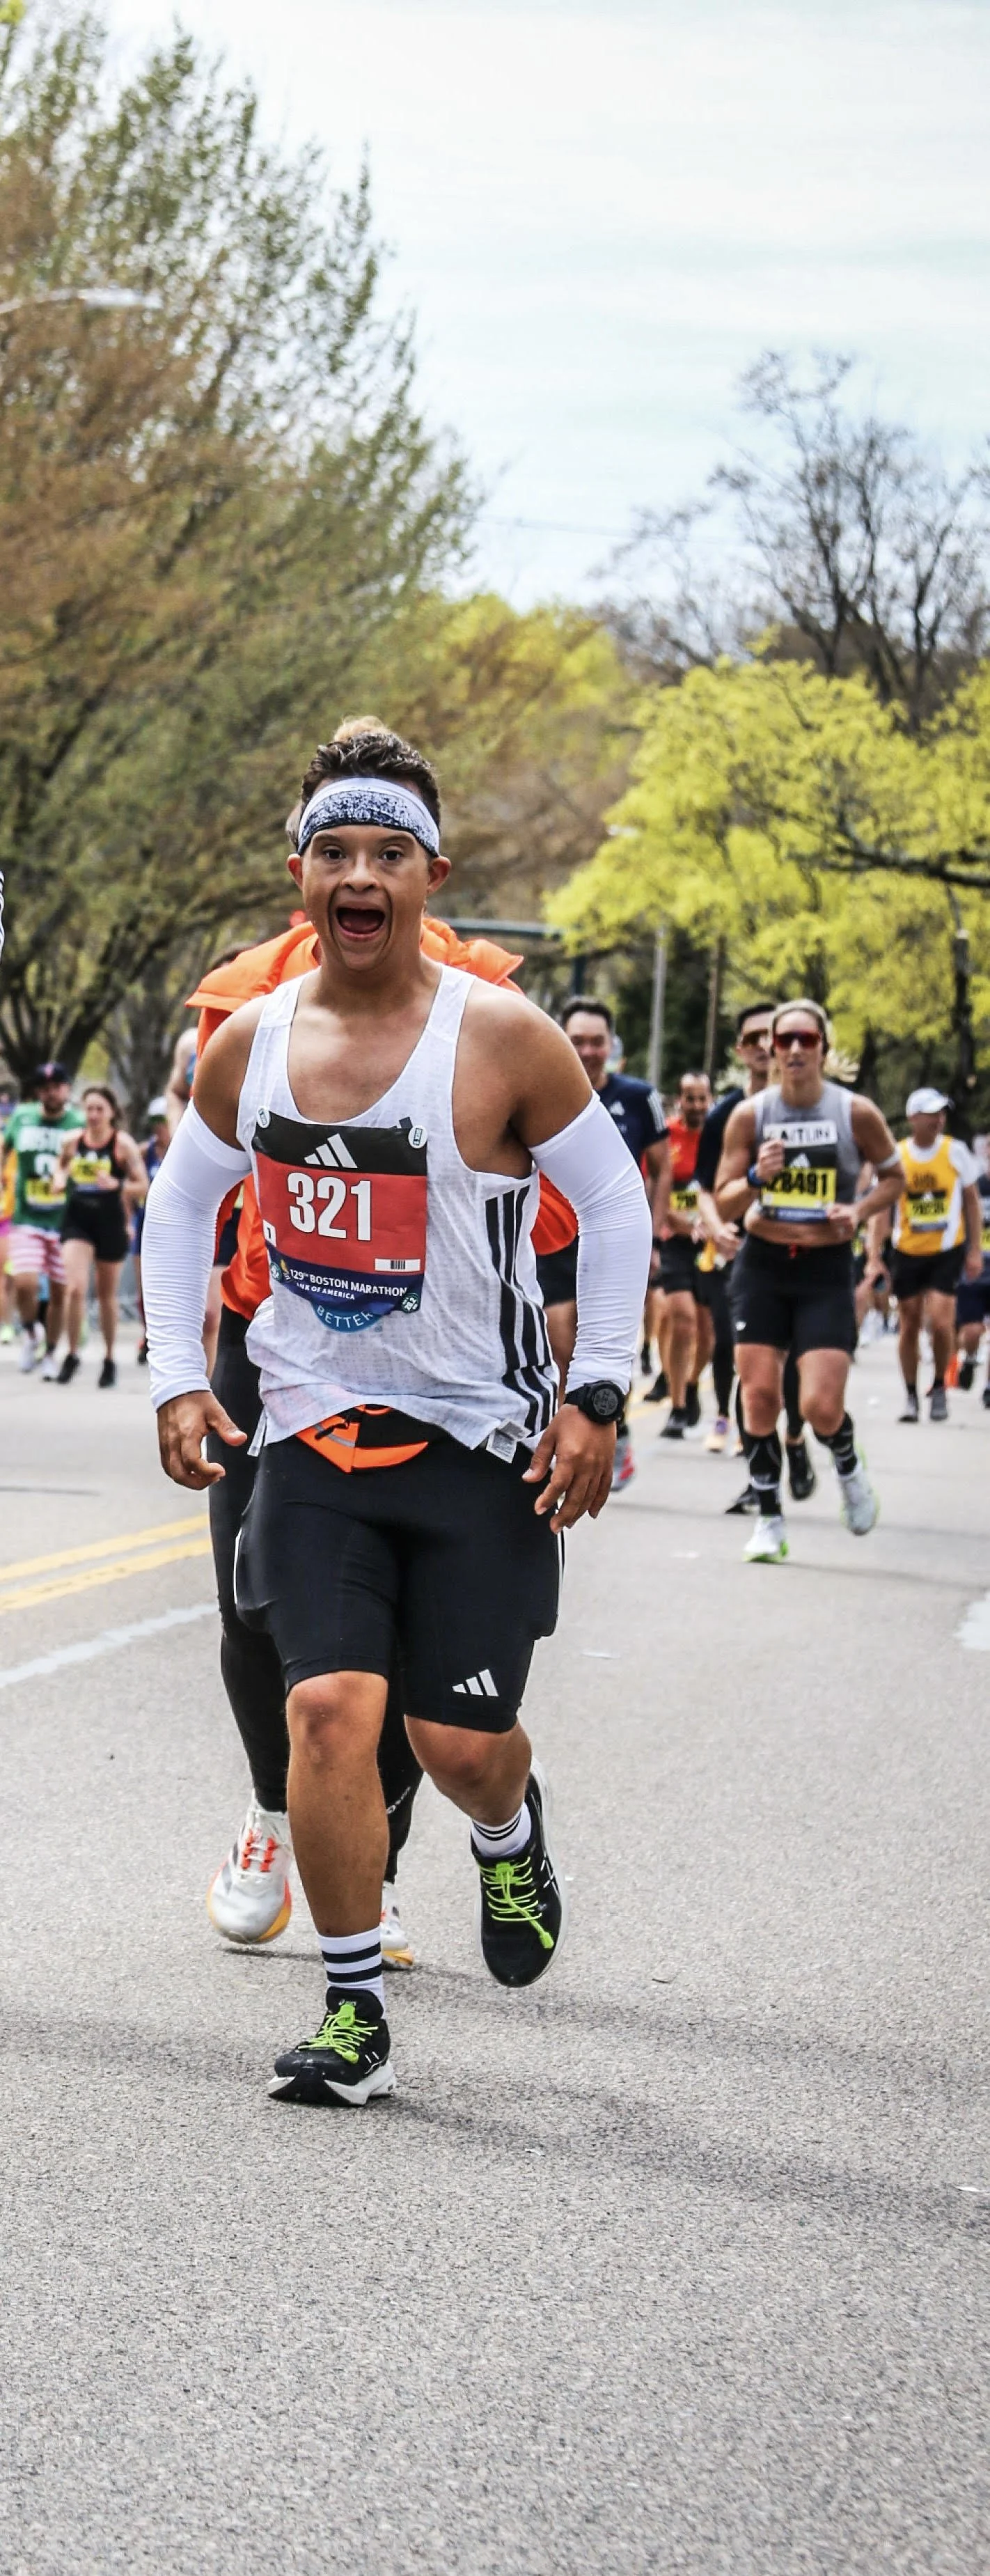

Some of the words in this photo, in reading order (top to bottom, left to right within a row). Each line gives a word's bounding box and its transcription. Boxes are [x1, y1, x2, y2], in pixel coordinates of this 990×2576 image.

[288, 1171, 371, 1241] 321
[310, 1274, 348, 1290] BOSTON
[350, 1281, 407, 1297] MARATHON
[322, 1288, 355, 1300] AMERICA
